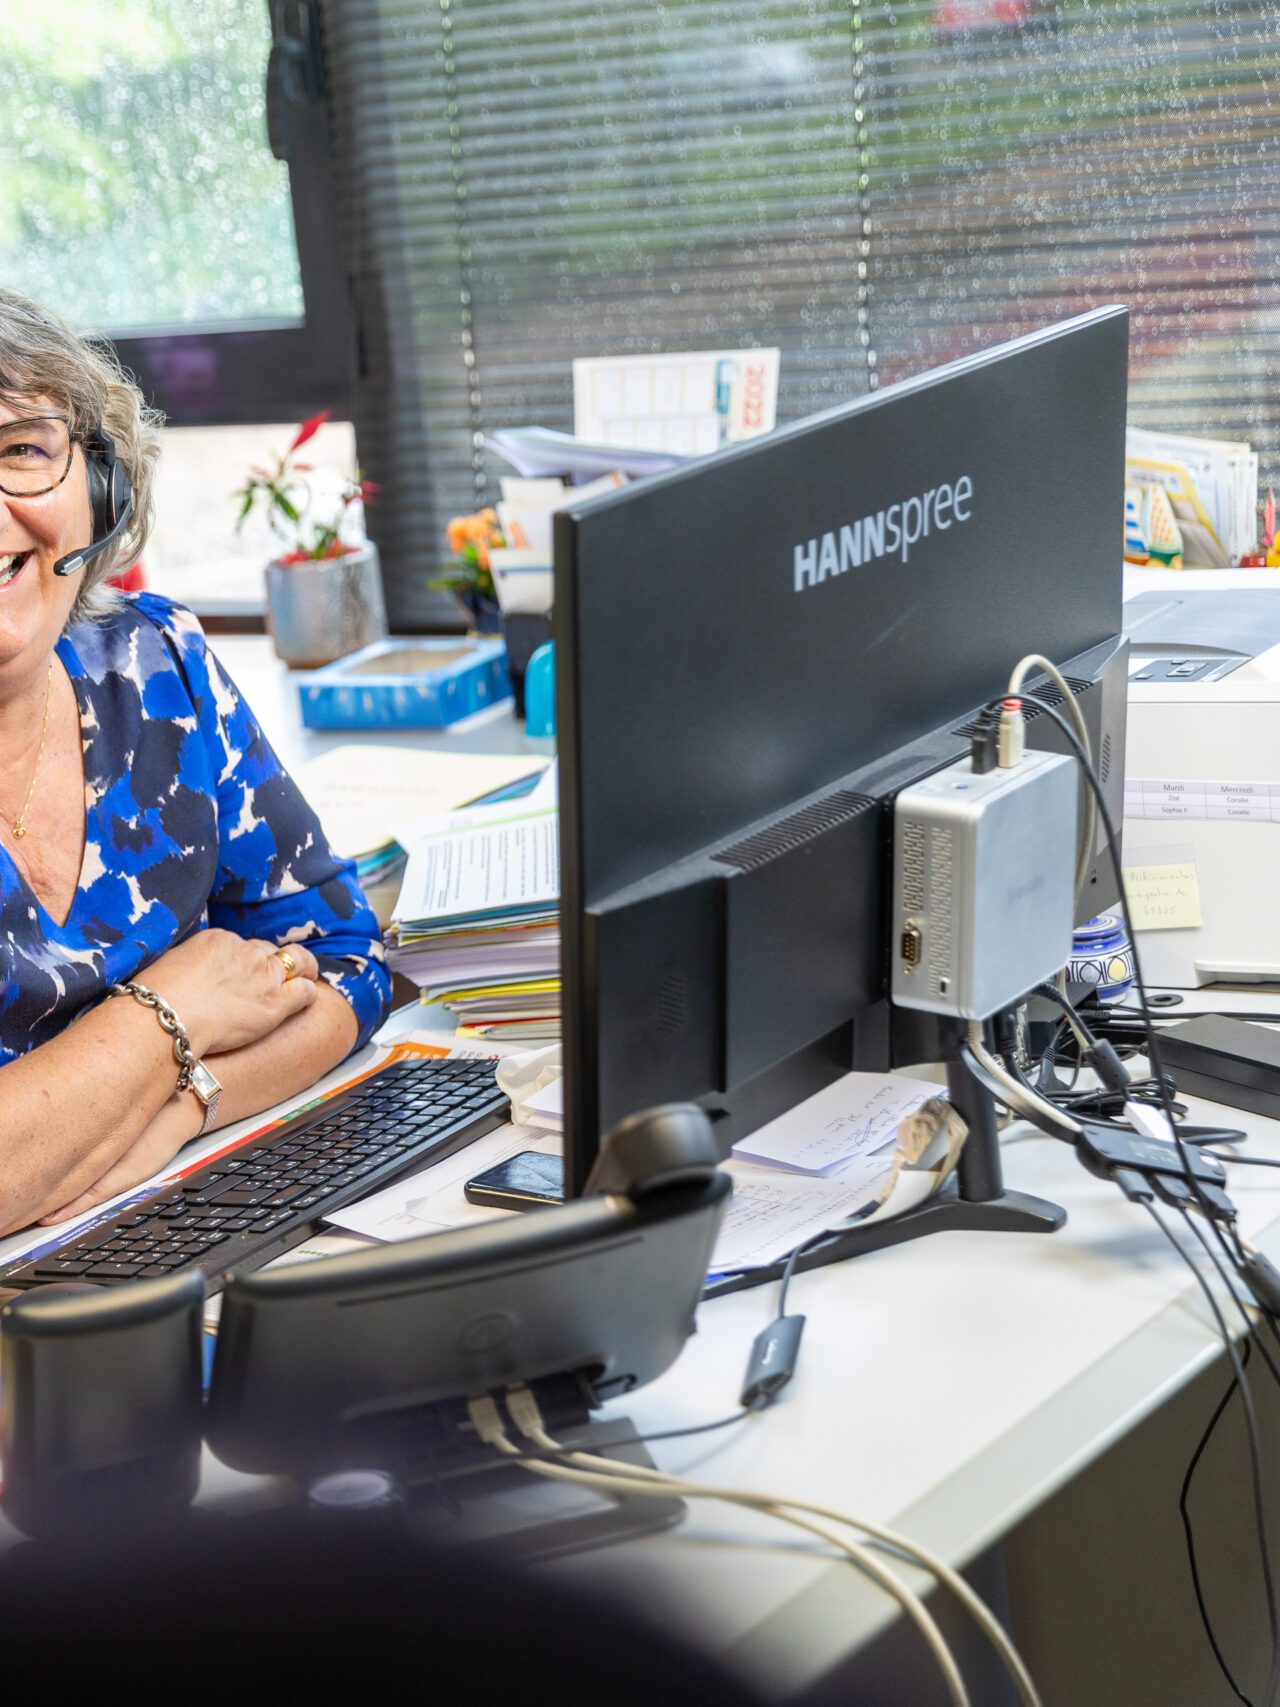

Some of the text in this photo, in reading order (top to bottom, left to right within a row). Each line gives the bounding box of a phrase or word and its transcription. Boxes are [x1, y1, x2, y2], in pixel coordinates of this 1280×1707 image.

[742, 365, 767, 429] 2022
[794, 475, 973, 593] HANNspree
[1163, 784, 1185, 792] Mardi
[1220, 785, 1254, 794] Mercredi
[1226, 796, 1249, 804] Coralie
[1227, 808, 1250, 816] Coralie
